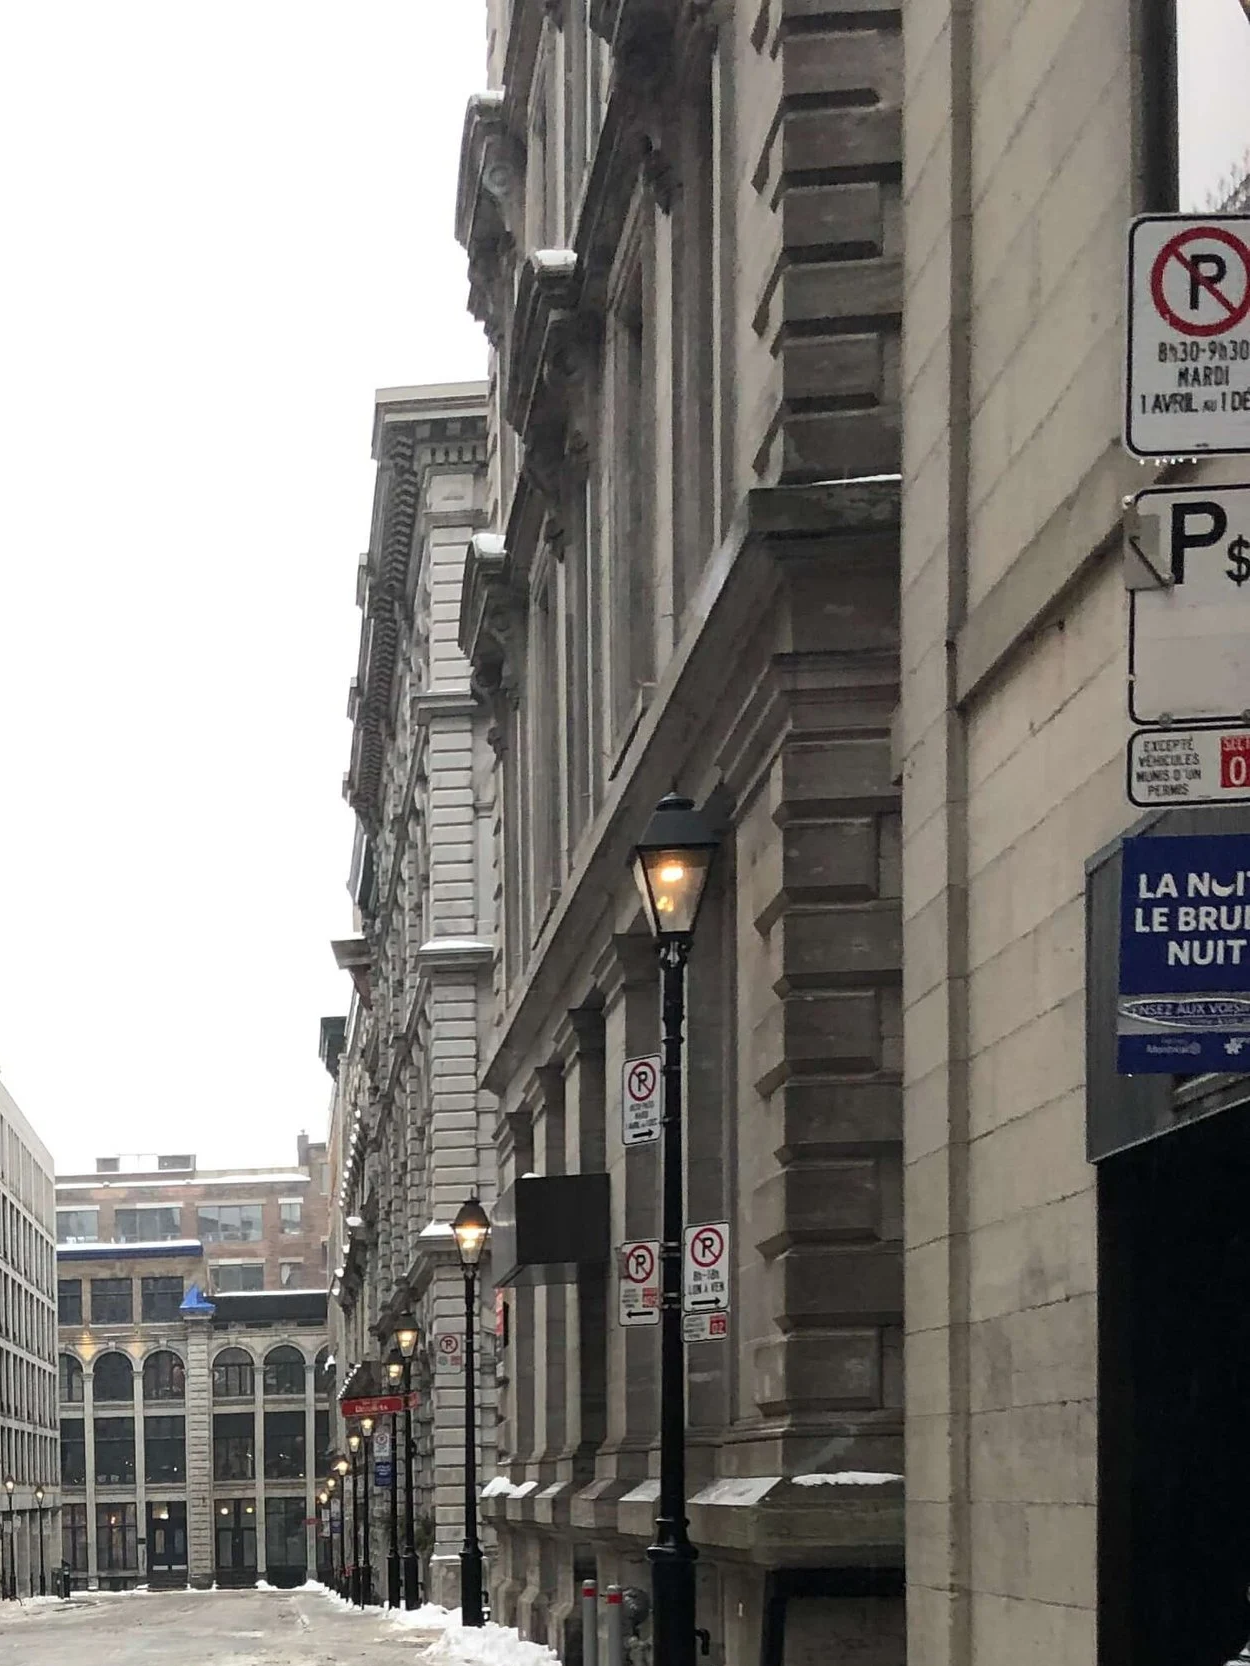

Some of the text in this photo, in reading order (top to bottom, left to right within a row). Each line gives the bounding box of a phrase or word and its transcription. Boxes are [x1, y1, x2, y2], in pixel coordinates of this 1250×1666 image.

[1158, 339, 1250, 363] 8h30-9h30
[1177, 365, 1230, 387] MARDI
[1140, 393, 1147, 414] 1
[1151, 392, 1198, 414] AVRIL
[1221, 391, 1227, 412] 1
[1171, 500, 1250, 587] P $
[1147, 783, 1189, 796] PERMIS
[1138, 871, 1250, 899] LA NUI
[1134, 907, 1169, 933] LE
[1167, 939, 1247, 966] NUIT
[1177, 1003, 1205, 1015] AUX
